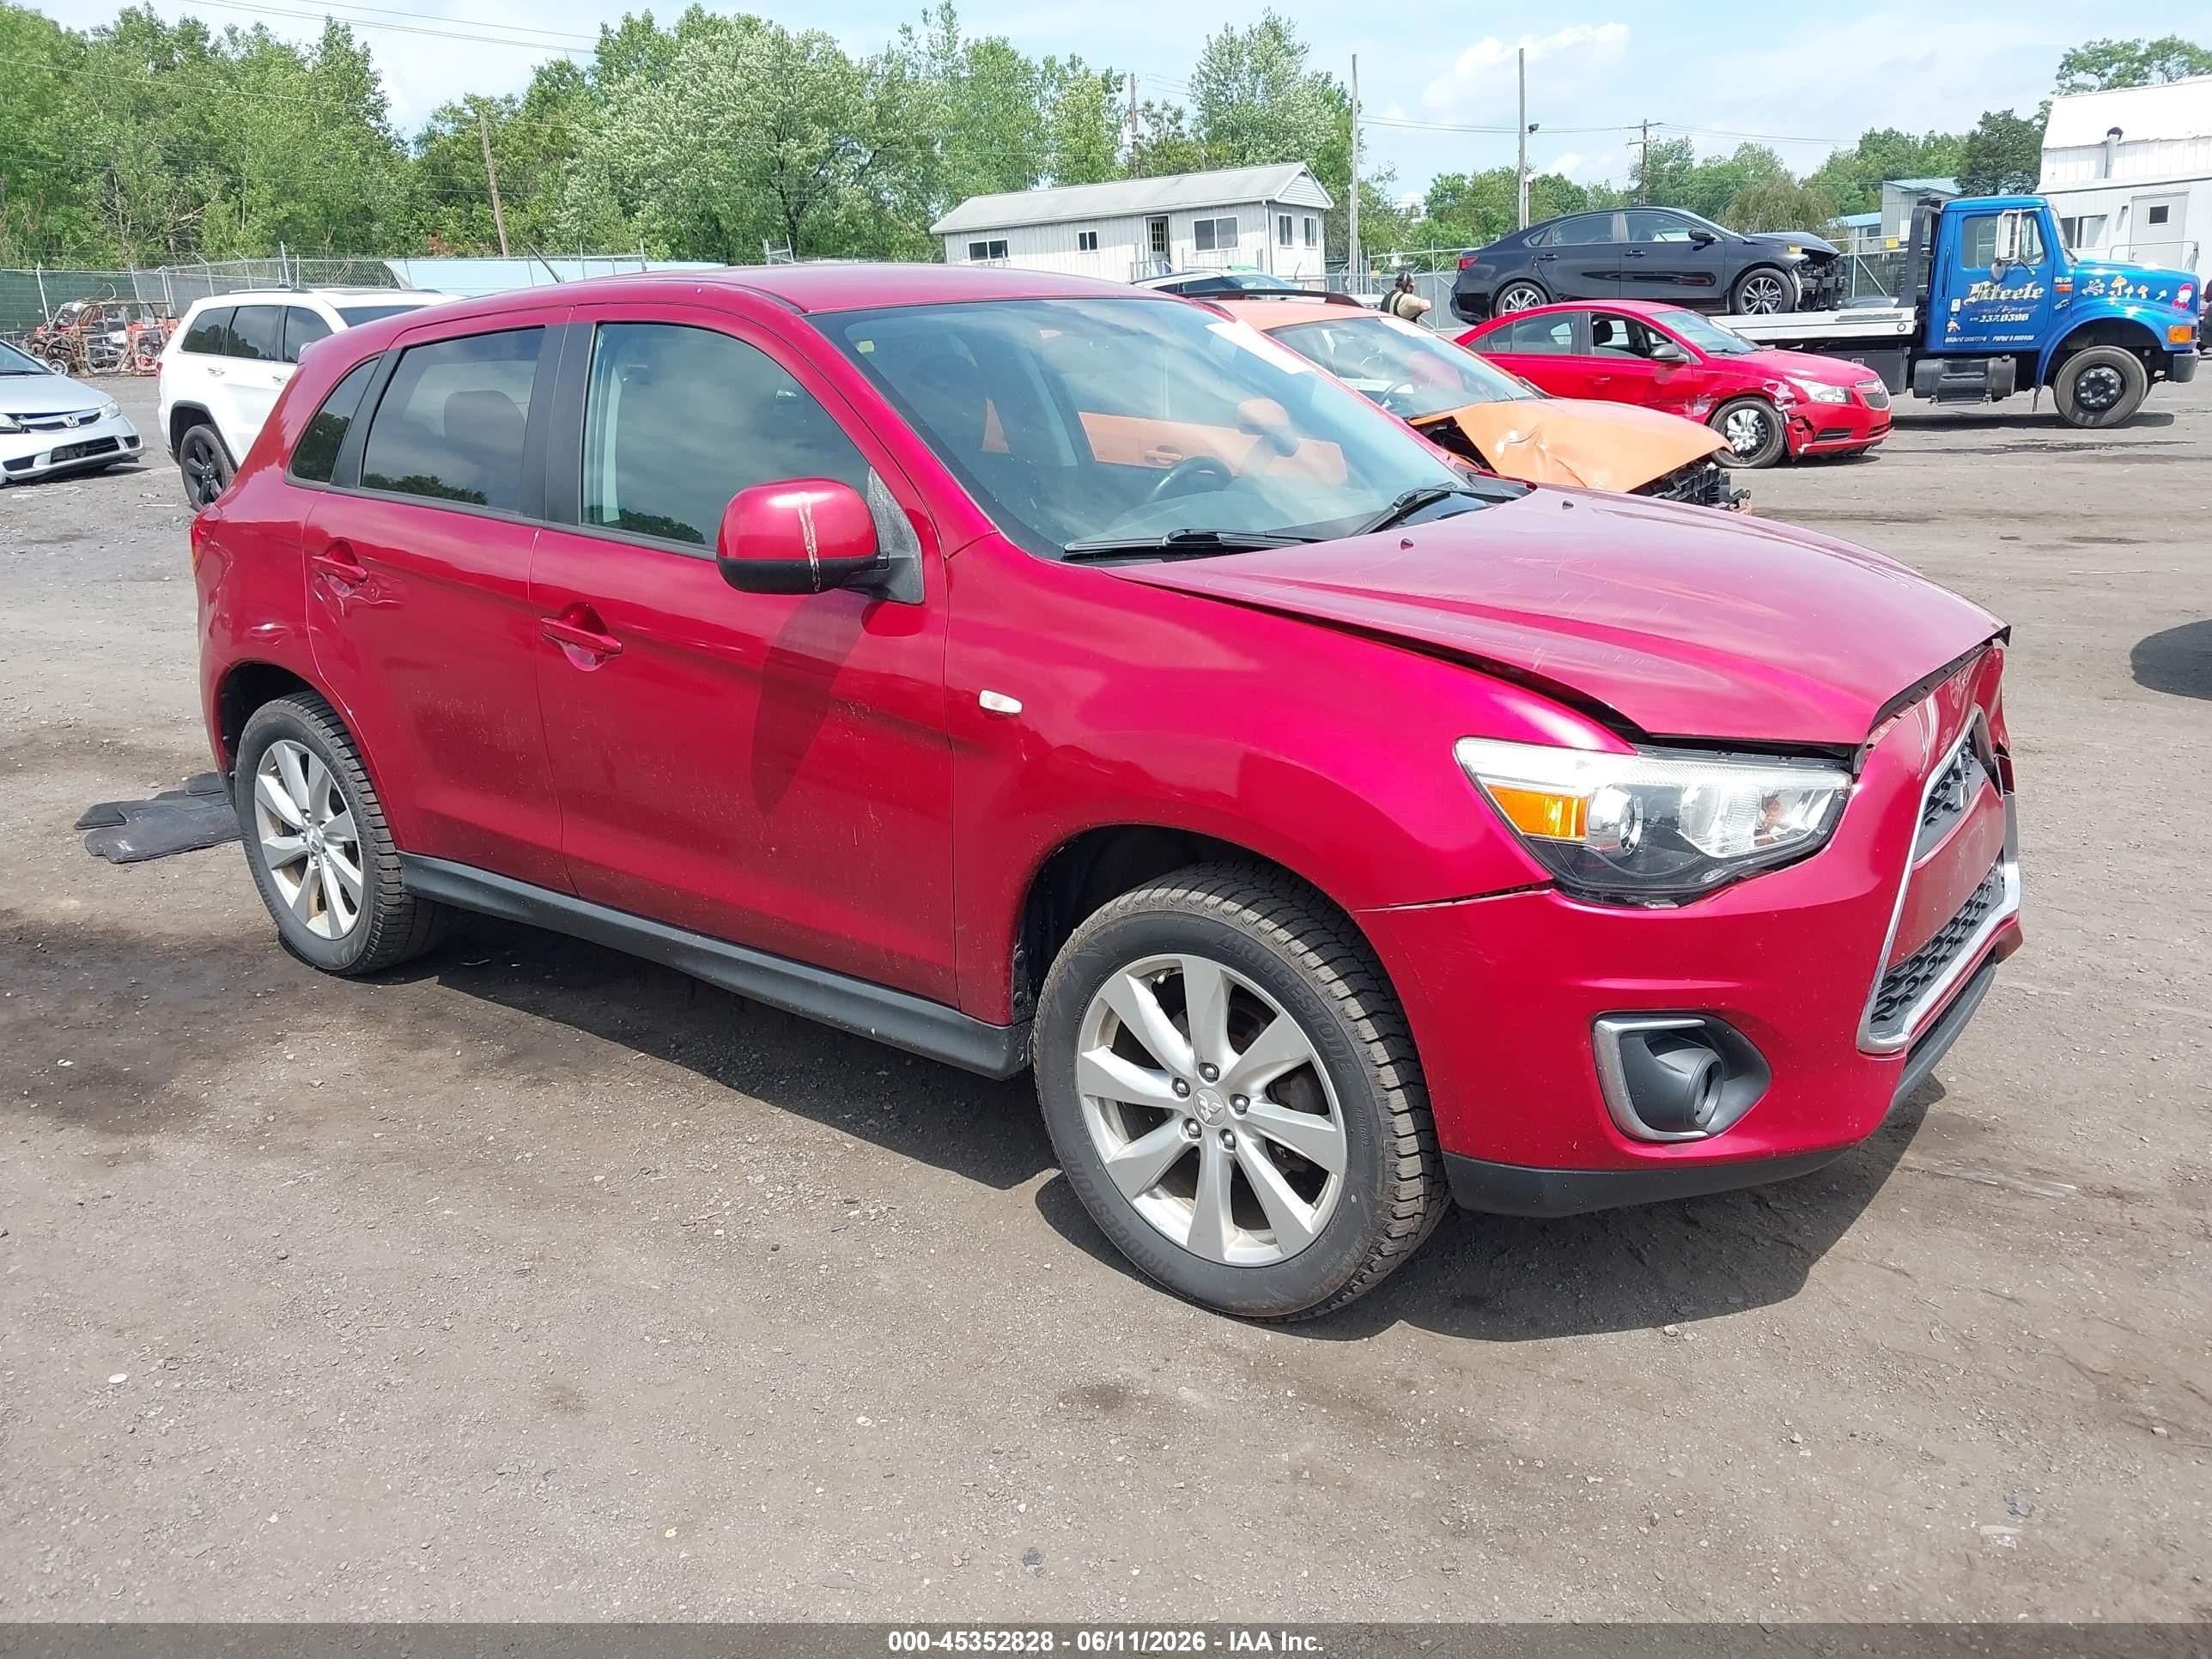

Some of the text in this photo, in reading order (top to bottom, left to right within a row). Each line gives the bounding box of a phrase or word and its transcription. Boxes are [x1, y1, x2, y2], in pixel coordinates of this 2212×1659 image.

[1963, 280, 2045, 306] Steele
[1216, 931, 1358, 1074] BRIDGESTONE
[1057, 1145, 1176, 1278] BRIDGESTONE
